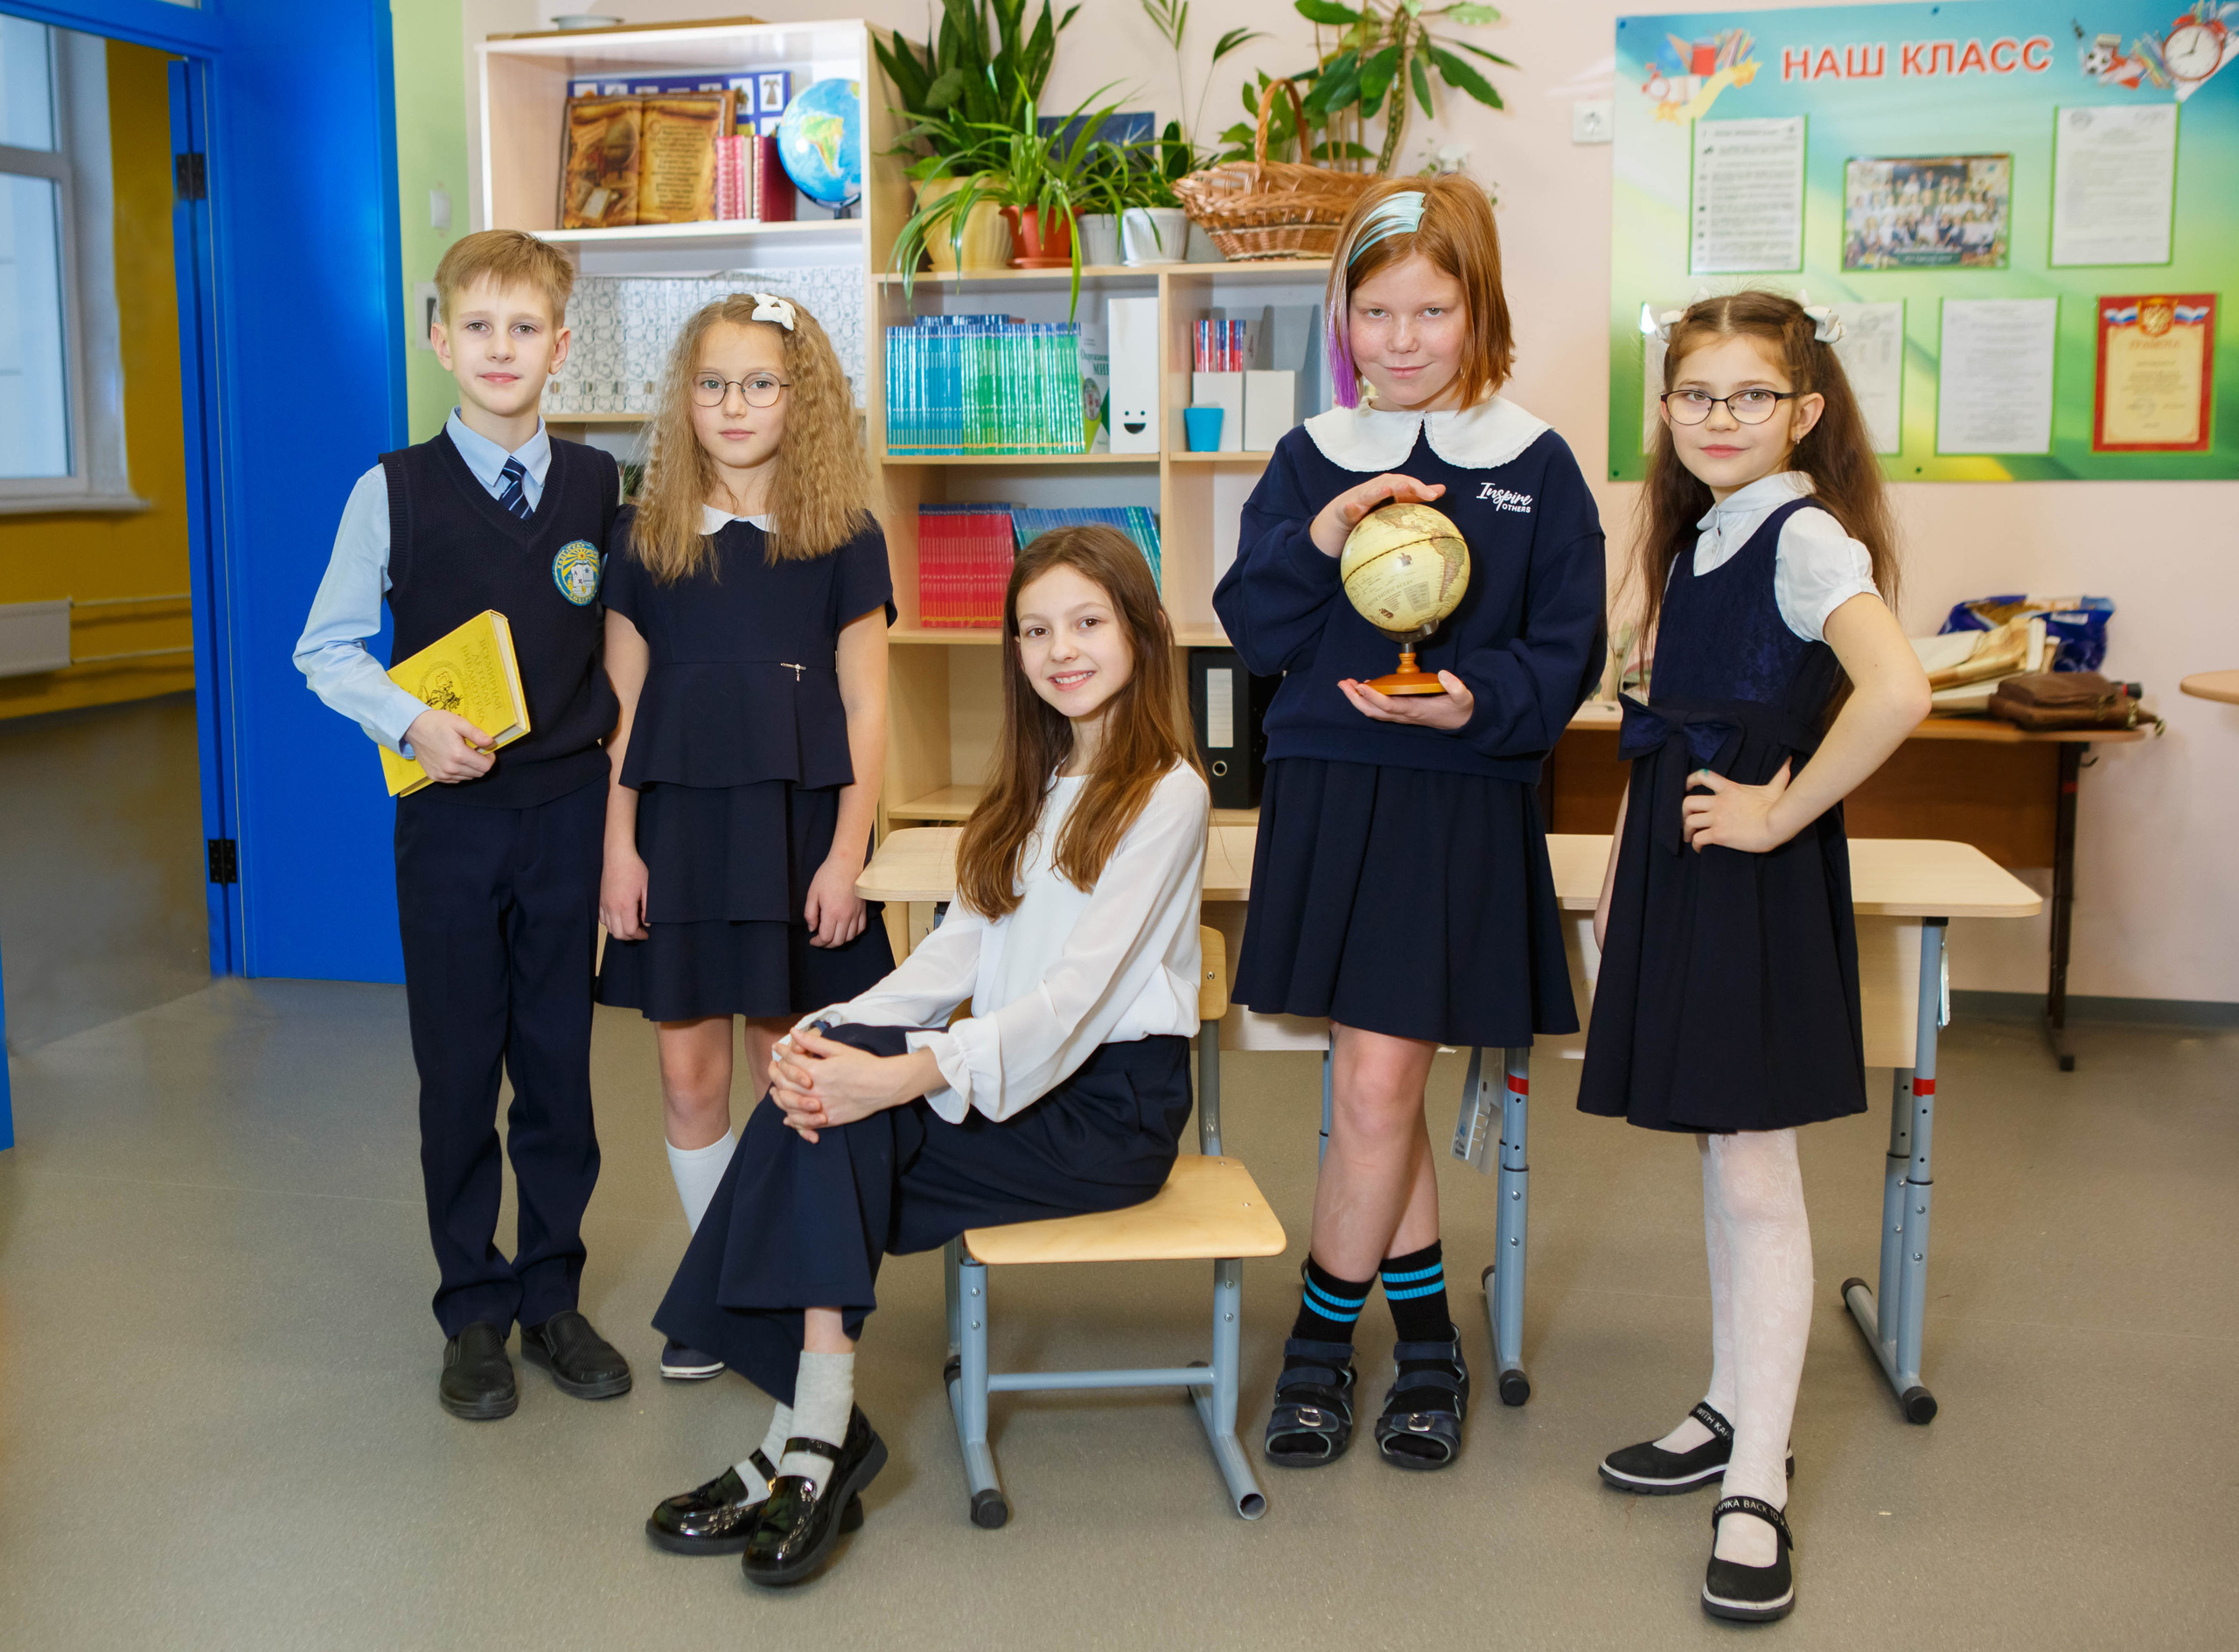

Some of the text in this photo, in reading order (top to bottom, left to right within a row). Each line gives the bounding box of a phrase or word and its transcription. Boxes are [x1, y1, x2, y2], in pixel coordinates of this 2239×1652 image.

[1782, 38, 2053, 81] НАШ КЛАСС
[1475, 482, 1533, 512] Inspire
[1502, 503, 1531, 513] OTHERS
[461, 644, 486, 724] БИБЛИОТЕКА
[472, 653, 492, 707] ДЕТСКАЯ
[479, 638, 503, 710] ВСЕМИРНАЯ
[1697, 1407, 1716, 1425] WITH
[1743, 1499, 1768, 1515] BACK
[1770, 1509, 1779, 1522] TO
